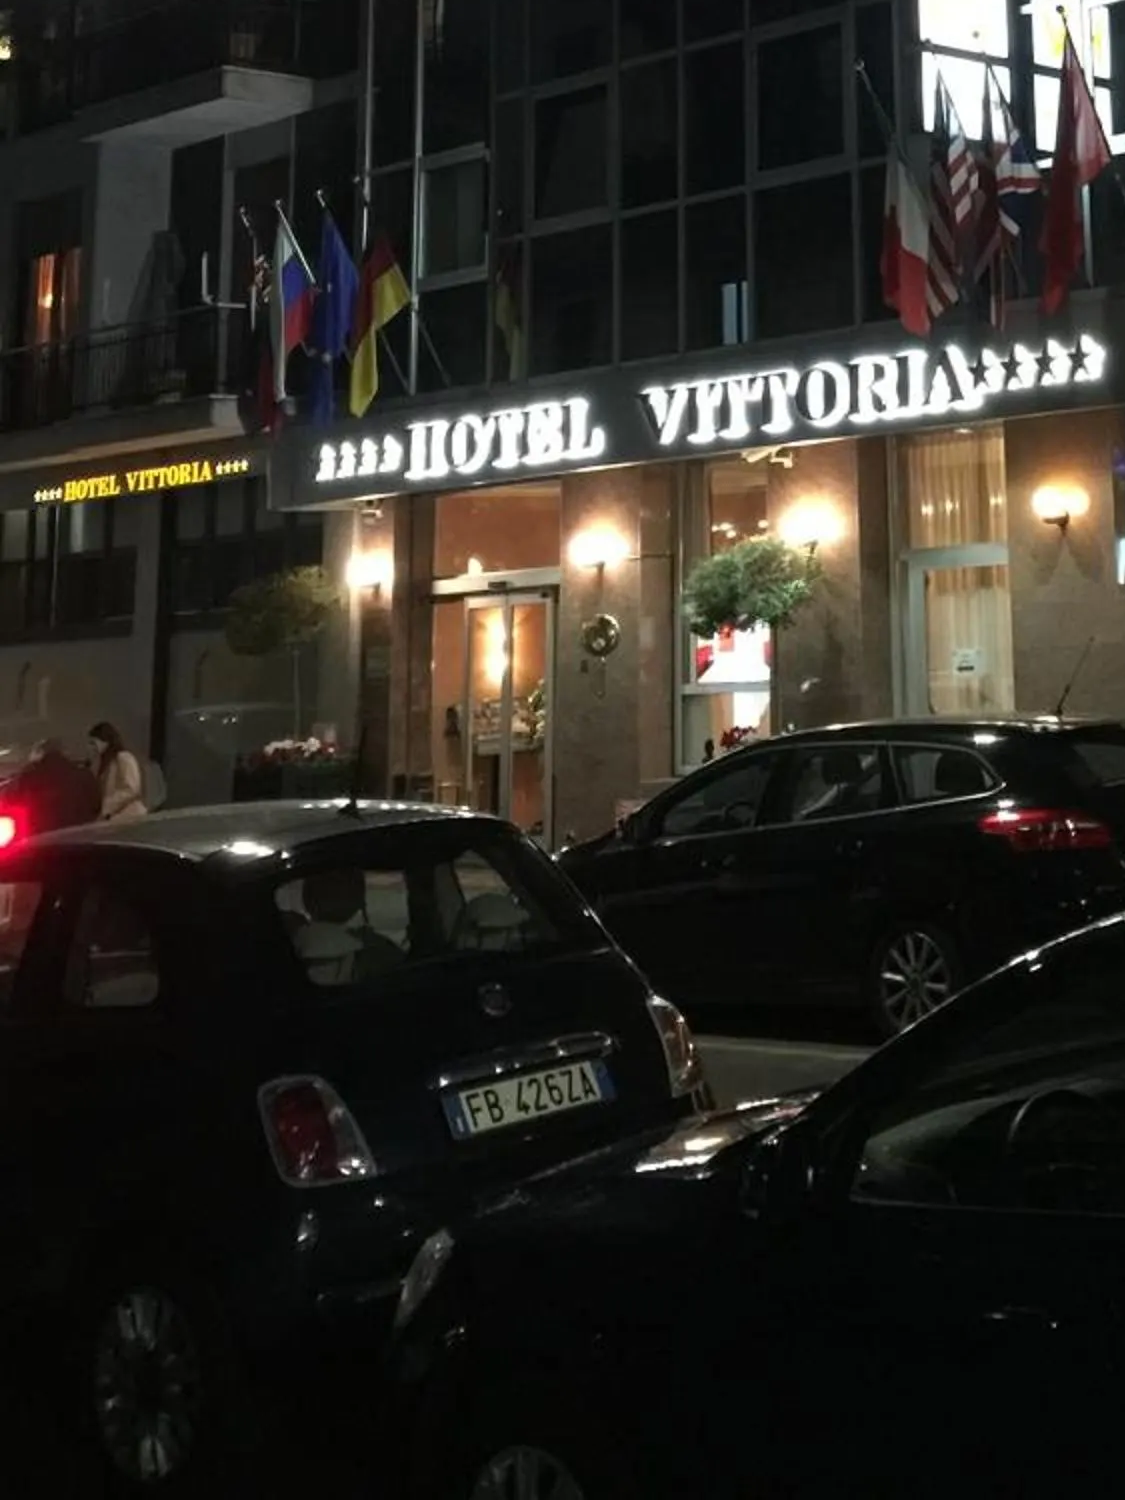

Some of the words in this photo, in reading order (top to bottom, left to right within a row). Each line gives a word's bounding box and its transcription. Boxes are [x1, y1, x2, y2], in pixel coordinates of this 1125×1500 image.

[404, 397, 605, 481] HOTEL
[638, 344, 982, 445] VITTORIA
[64, 475, 121, 503] HOTEL
[125, 460, 214, 493] VITTORIA
[464, 1088, 505, 1129] FB
